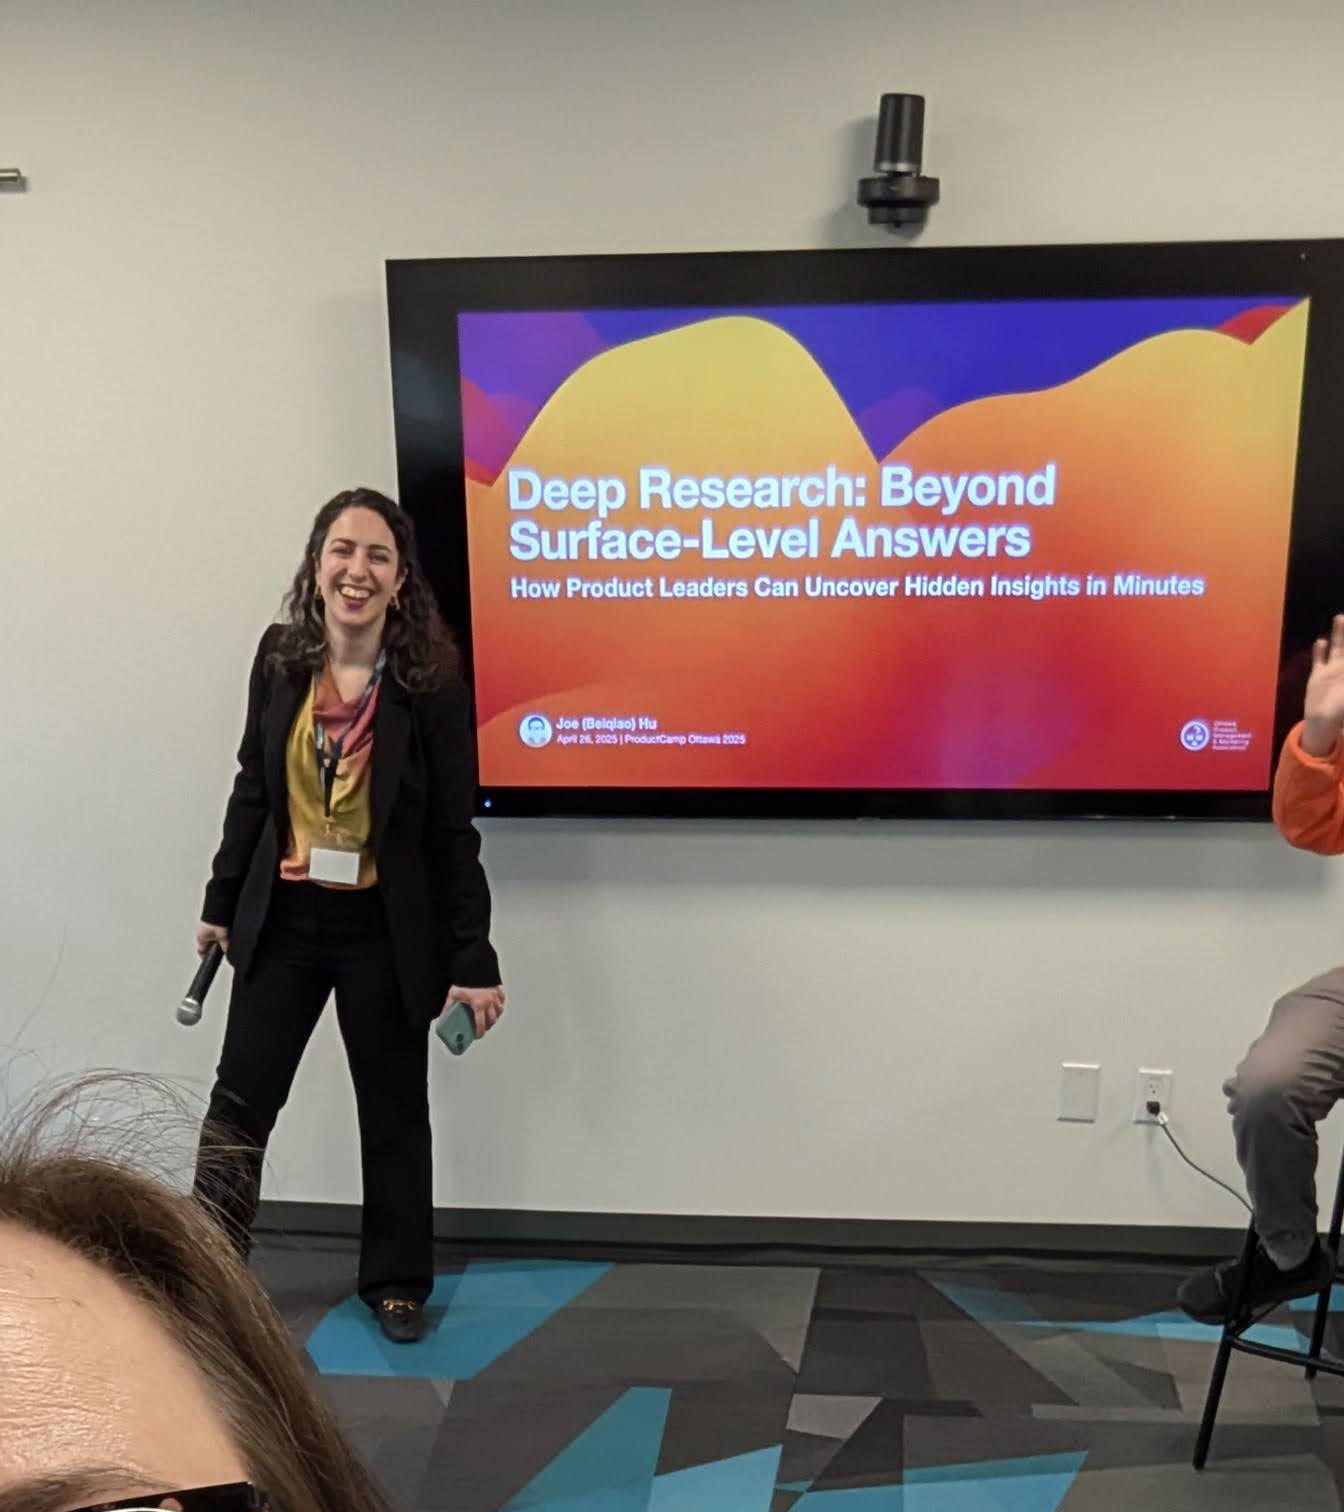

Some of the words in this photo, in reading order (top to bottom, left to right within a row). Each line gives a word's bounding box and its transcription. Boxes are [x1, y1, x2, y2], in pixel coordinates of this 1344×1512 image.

[508, 468, 626, 518] Deep
[640, 464, 866, 510] Research:
[882, 464, 1056, 515] Beyond
[510, 518, 819, 561] Surface-Level
[831, 517, 1031, 558] Answers
[511, 577, 560, 598] How
[567, 577, 653, 598] Product
[660, 577, 748, 598] Leaders
[754, 577, 799, 597] Can
[806, 576, 899, 597] Uncover
[905, 575, 984, 597] Hidden
[991, 574, 1080, 600] Insights
[1086, 575, 1106, 596] in
[1113, 574, 1205, 596] Minutes
[556, 717, 579, 729] Joe
[638, 718, 657, 730] Hu
[557, 734, 577, 745] April
[595, 734, 618, 744] 2025
[722, 734, 746, 744] 2025
